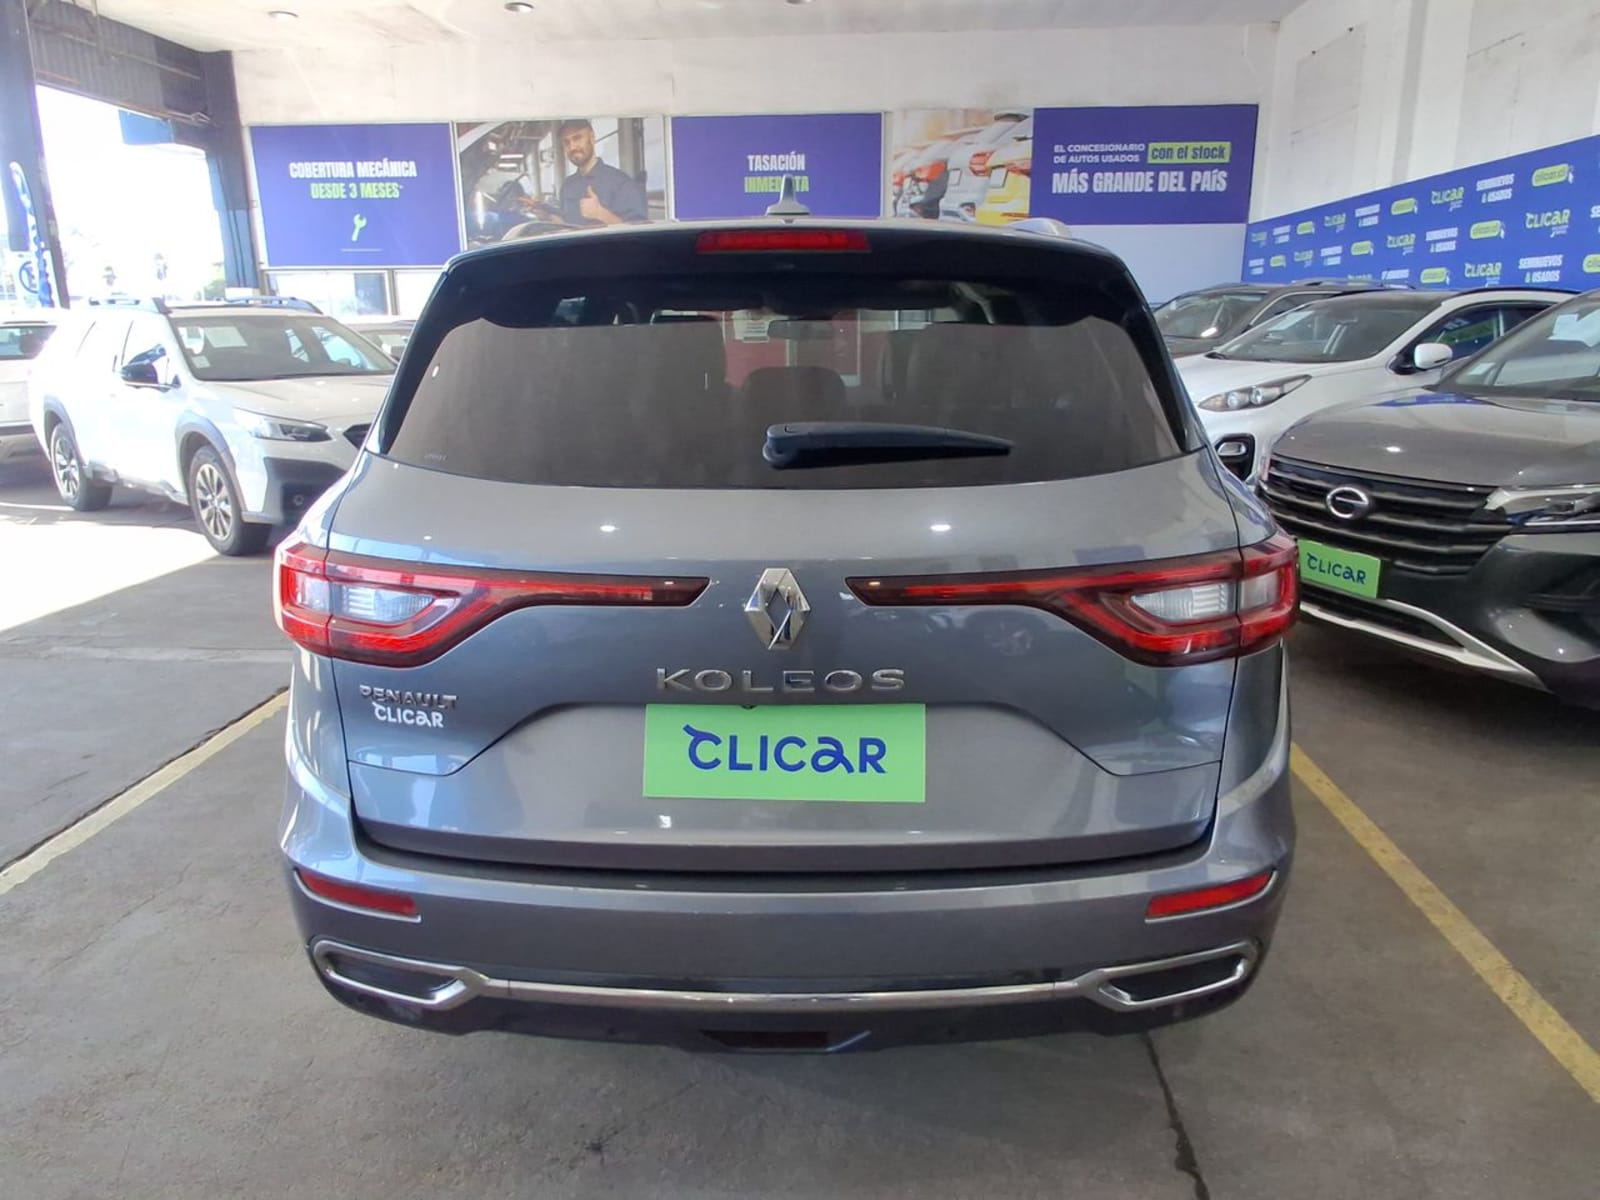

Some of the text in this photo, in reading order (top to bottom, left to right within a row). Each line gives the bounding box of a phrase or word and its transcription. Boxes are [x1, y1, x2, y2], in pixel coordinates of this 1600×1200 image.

[746, 150, 806, 171] TASACIÓN
[1053, 154, 1140, 164] DE AUTOS USADOS
[1054, 143, 1226, 160] EL CONCESIONARIO con el stock
[289, 157, 418, 178] COBERTURA MECÁNICA
[311, 183, 346, 198] DESDE
[349, 183, 358, 199] 3
[744, 175, 809, 193] INMEDTA
[1052, 168, 1089, 194] MÁS
[1093, 171, 1154, 193] GRANDE
[1158, 171, 1187, 192] DEL
[1307, 552, 1366, 585] CLICAR
[656, 668, 906, 693] KOLEOS
[372, 701, 444, 728] CLICAR
[683, 724, 888, 775] CLICAR
